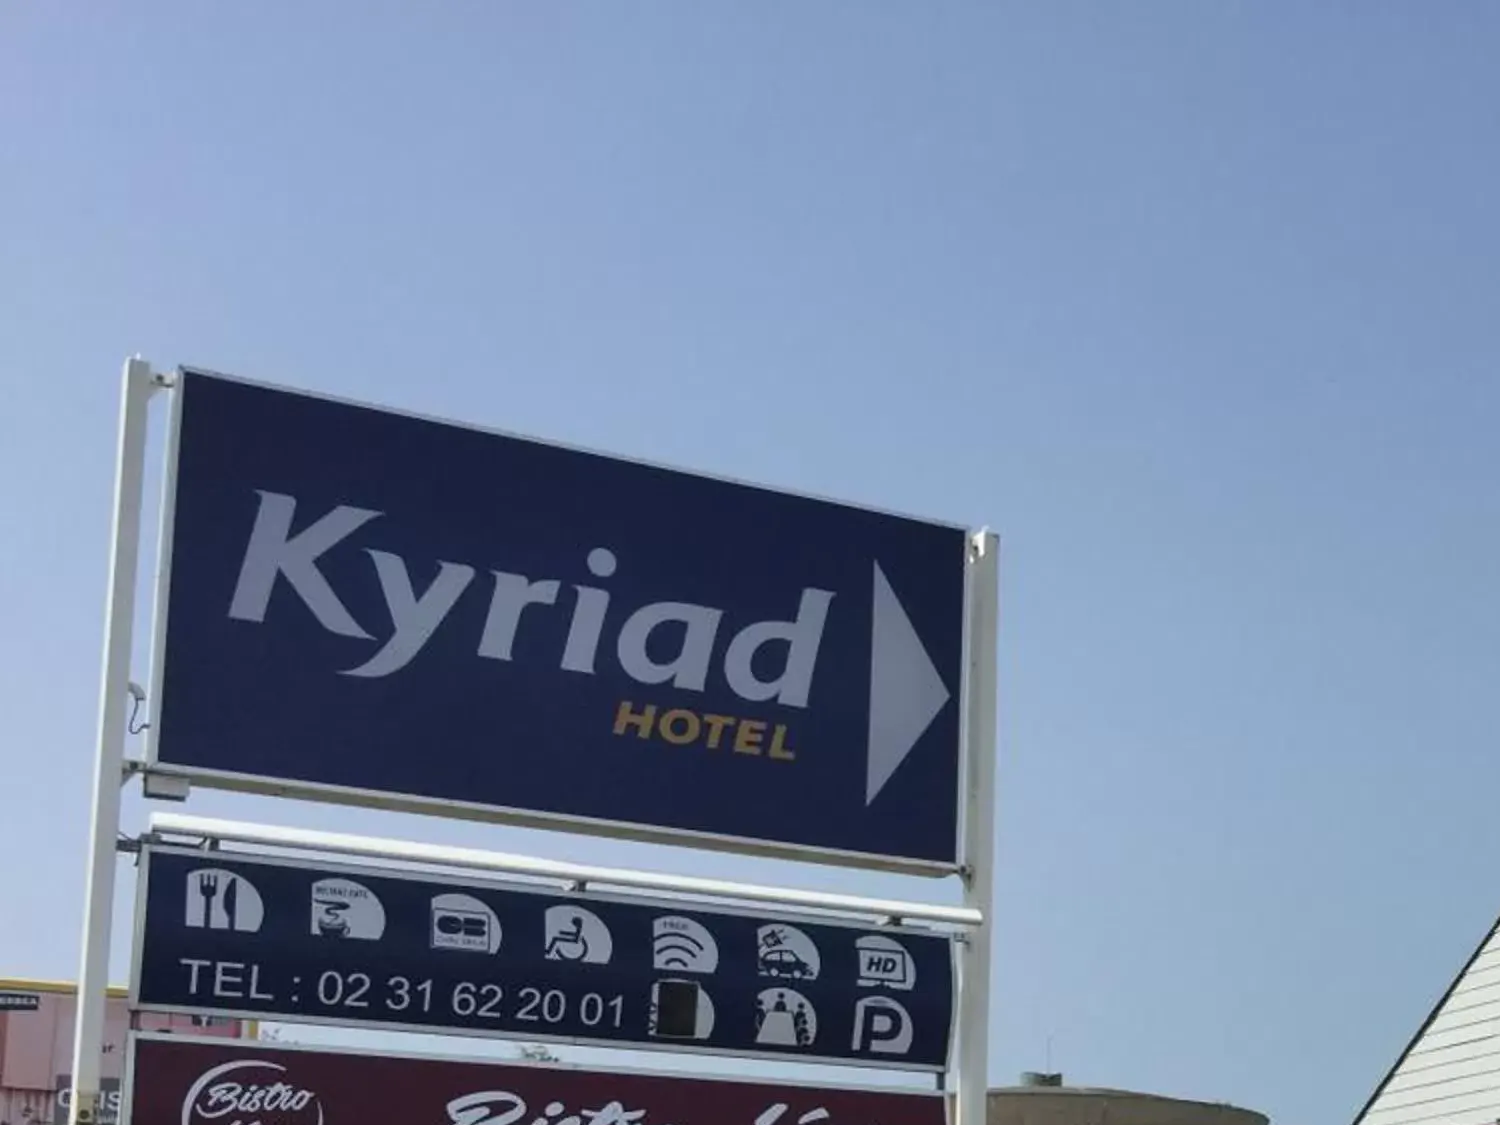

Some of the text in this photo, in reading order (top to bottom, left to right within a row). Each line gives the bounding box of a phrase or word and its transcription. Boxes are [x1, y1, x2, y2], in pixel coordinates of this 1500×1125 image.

[228, 489, 836, 708] Kyriad
[613, 700, 796, 761] HOTEL
[866, 957, 897, 973] HD
[180, 957, 274, 1000] TEL
[317, 970, 370, 1008] 02
[385, 976, 434, 1013] 31
[451, 982, 502, 1019] 62
[515, 987, 567, 1022] 20
[578, 992, 625, 1029] 01
[860, 1003, 903, 1052] P
[194, 1081, 314, 1118] Bistro
